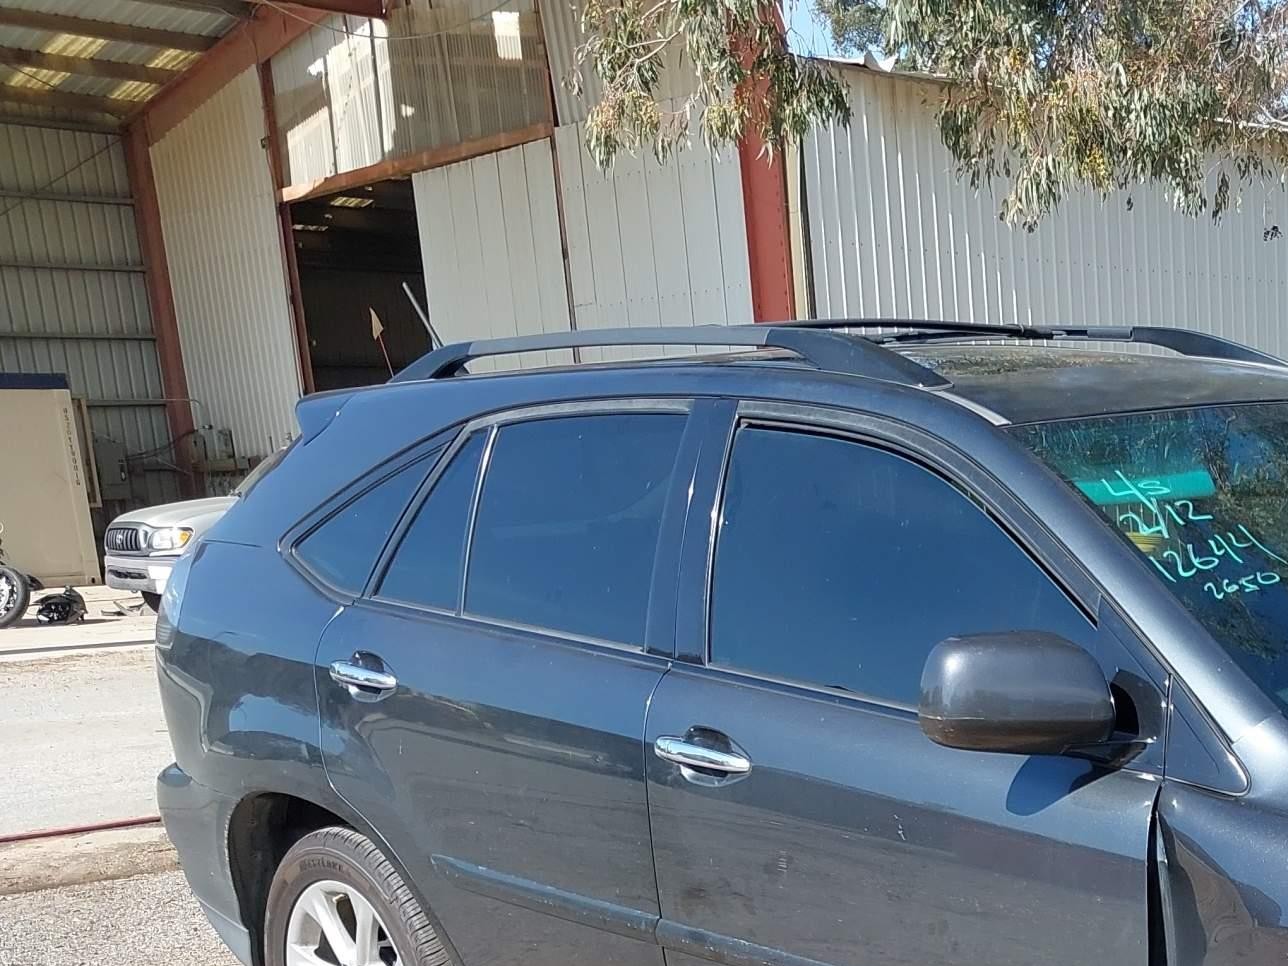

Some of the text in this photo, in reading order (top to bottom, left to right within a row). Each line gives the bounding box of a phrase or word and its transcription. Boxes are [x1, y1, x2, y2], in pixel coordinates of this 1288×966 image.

[1119, 496, 1213, 538] 2/12
[1149, 524, 1288, 583] 12644
[1204, 571, 1281, 599] 2650
